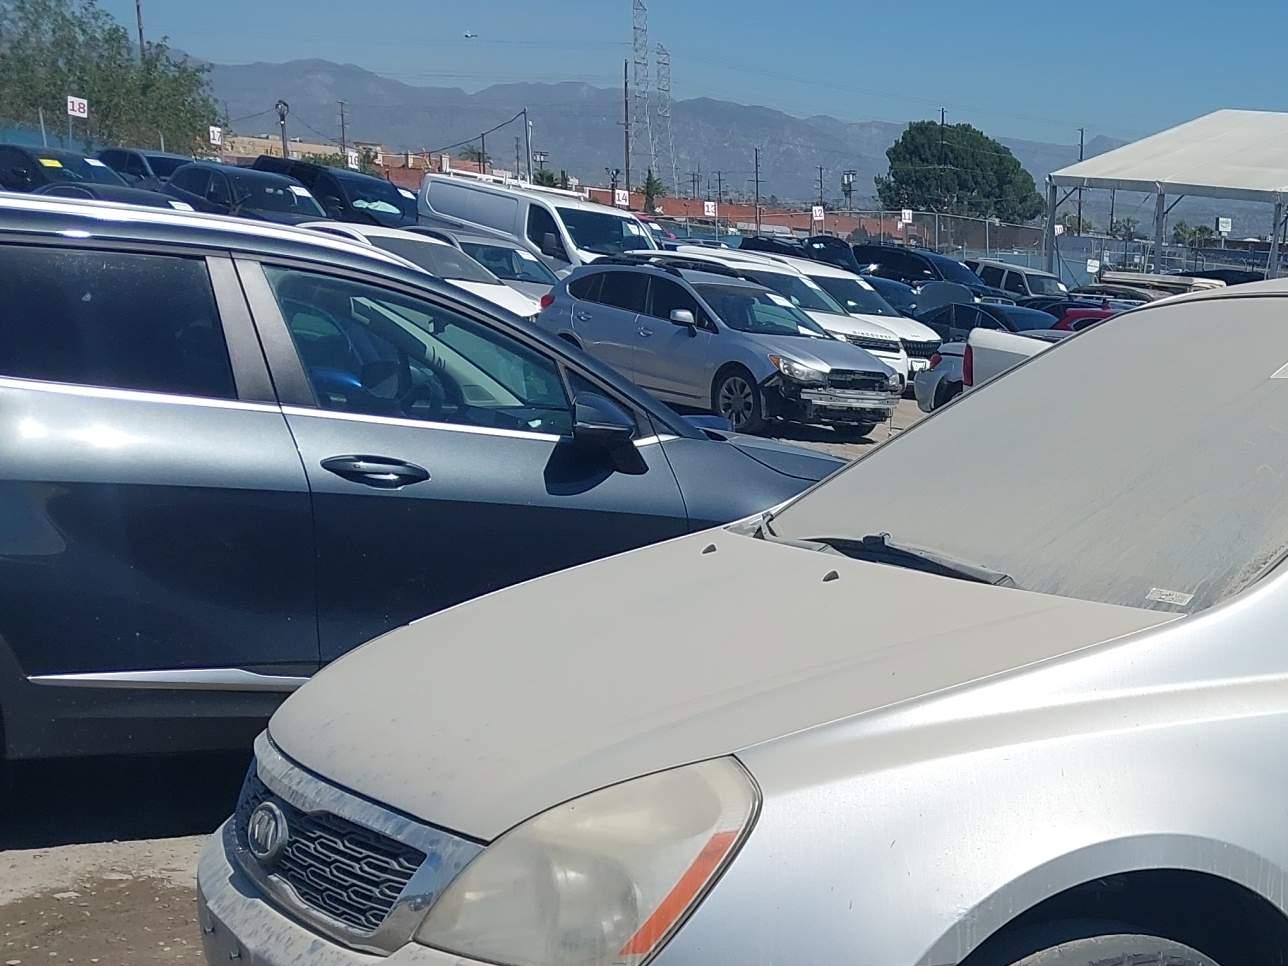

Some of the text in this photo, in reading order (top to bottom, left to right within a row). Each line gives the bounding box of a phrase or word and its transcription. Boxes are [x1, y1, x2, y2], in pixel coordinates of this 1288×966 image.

[69, 101, 86, 114] 18
[210, 130, 222, 142] 17
[616, 192, 628, 203] 14
[813, 208, 824, 218] 12
